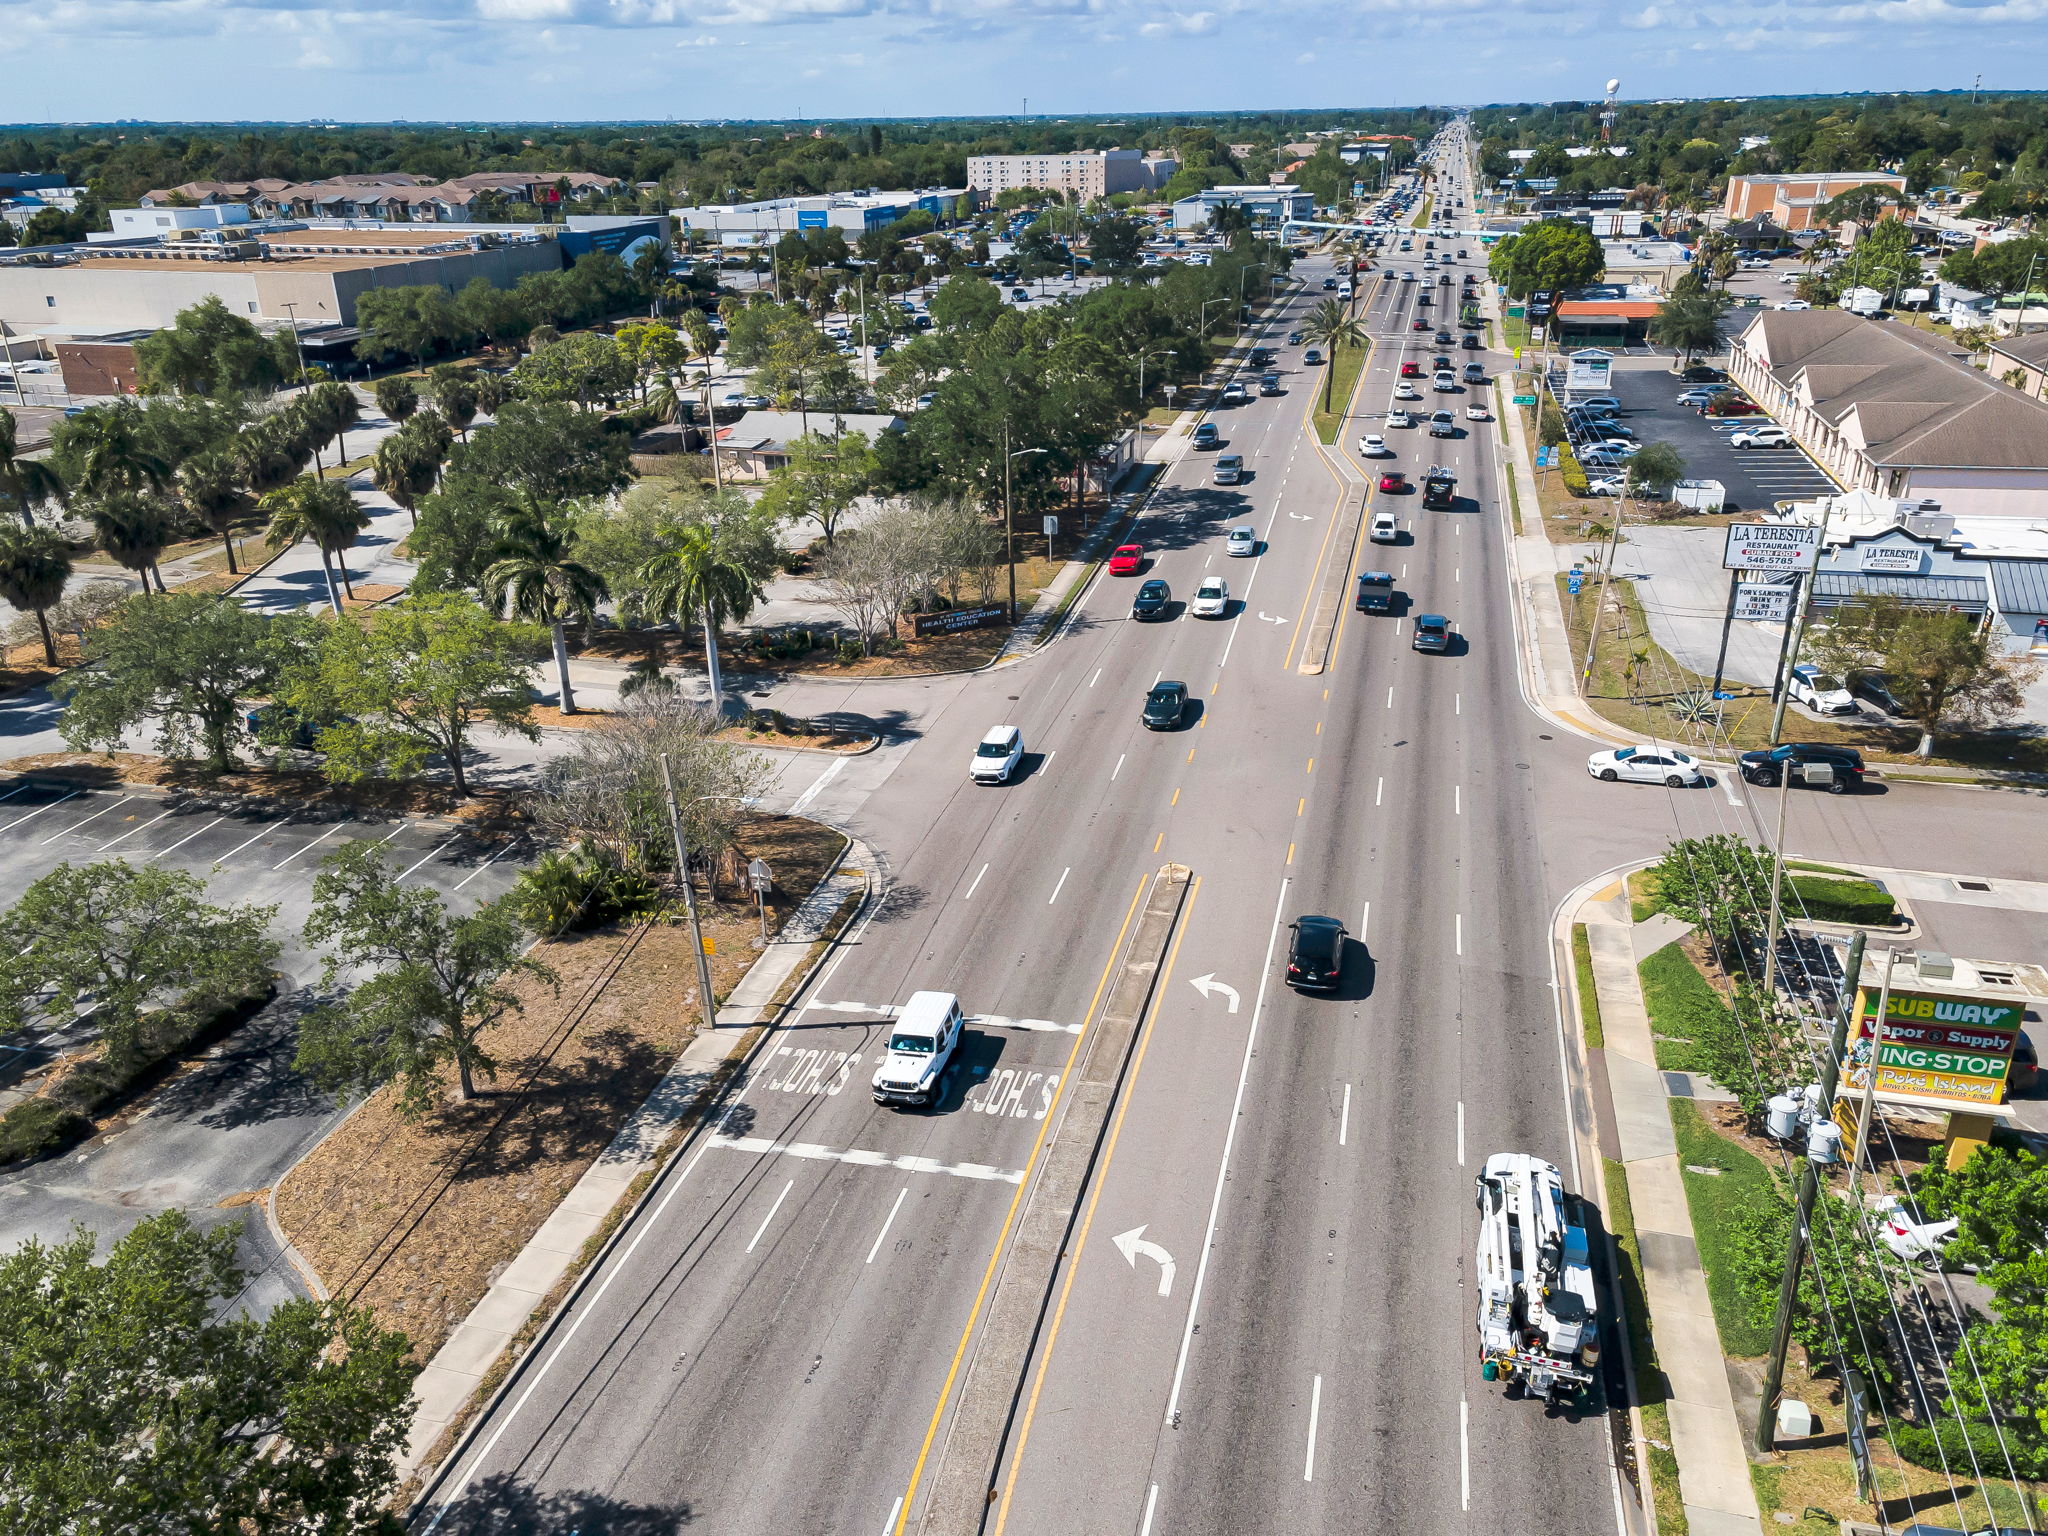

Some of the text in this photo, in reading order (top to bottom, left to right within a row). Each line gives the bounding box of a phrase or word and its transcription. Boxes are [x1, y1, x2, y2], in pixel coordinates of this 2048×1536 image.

[1733, 526, 1814, 544] LA TERESITA
[1746, 556, 1794, 565] 546-5785
[1866, 548, 1919, 560] LA TERESITA
[922, 617, 954, 628] HEALTH
[956, 609, 1001, 621] EDUCATION
[945, 619, 979, 629] CENTER
[1885, 997, 2011, 1025] SUBWAY
[1947, 1031, 2011, 1051] Supply
[1882, 1070, 1996, 1095] Poké Island
